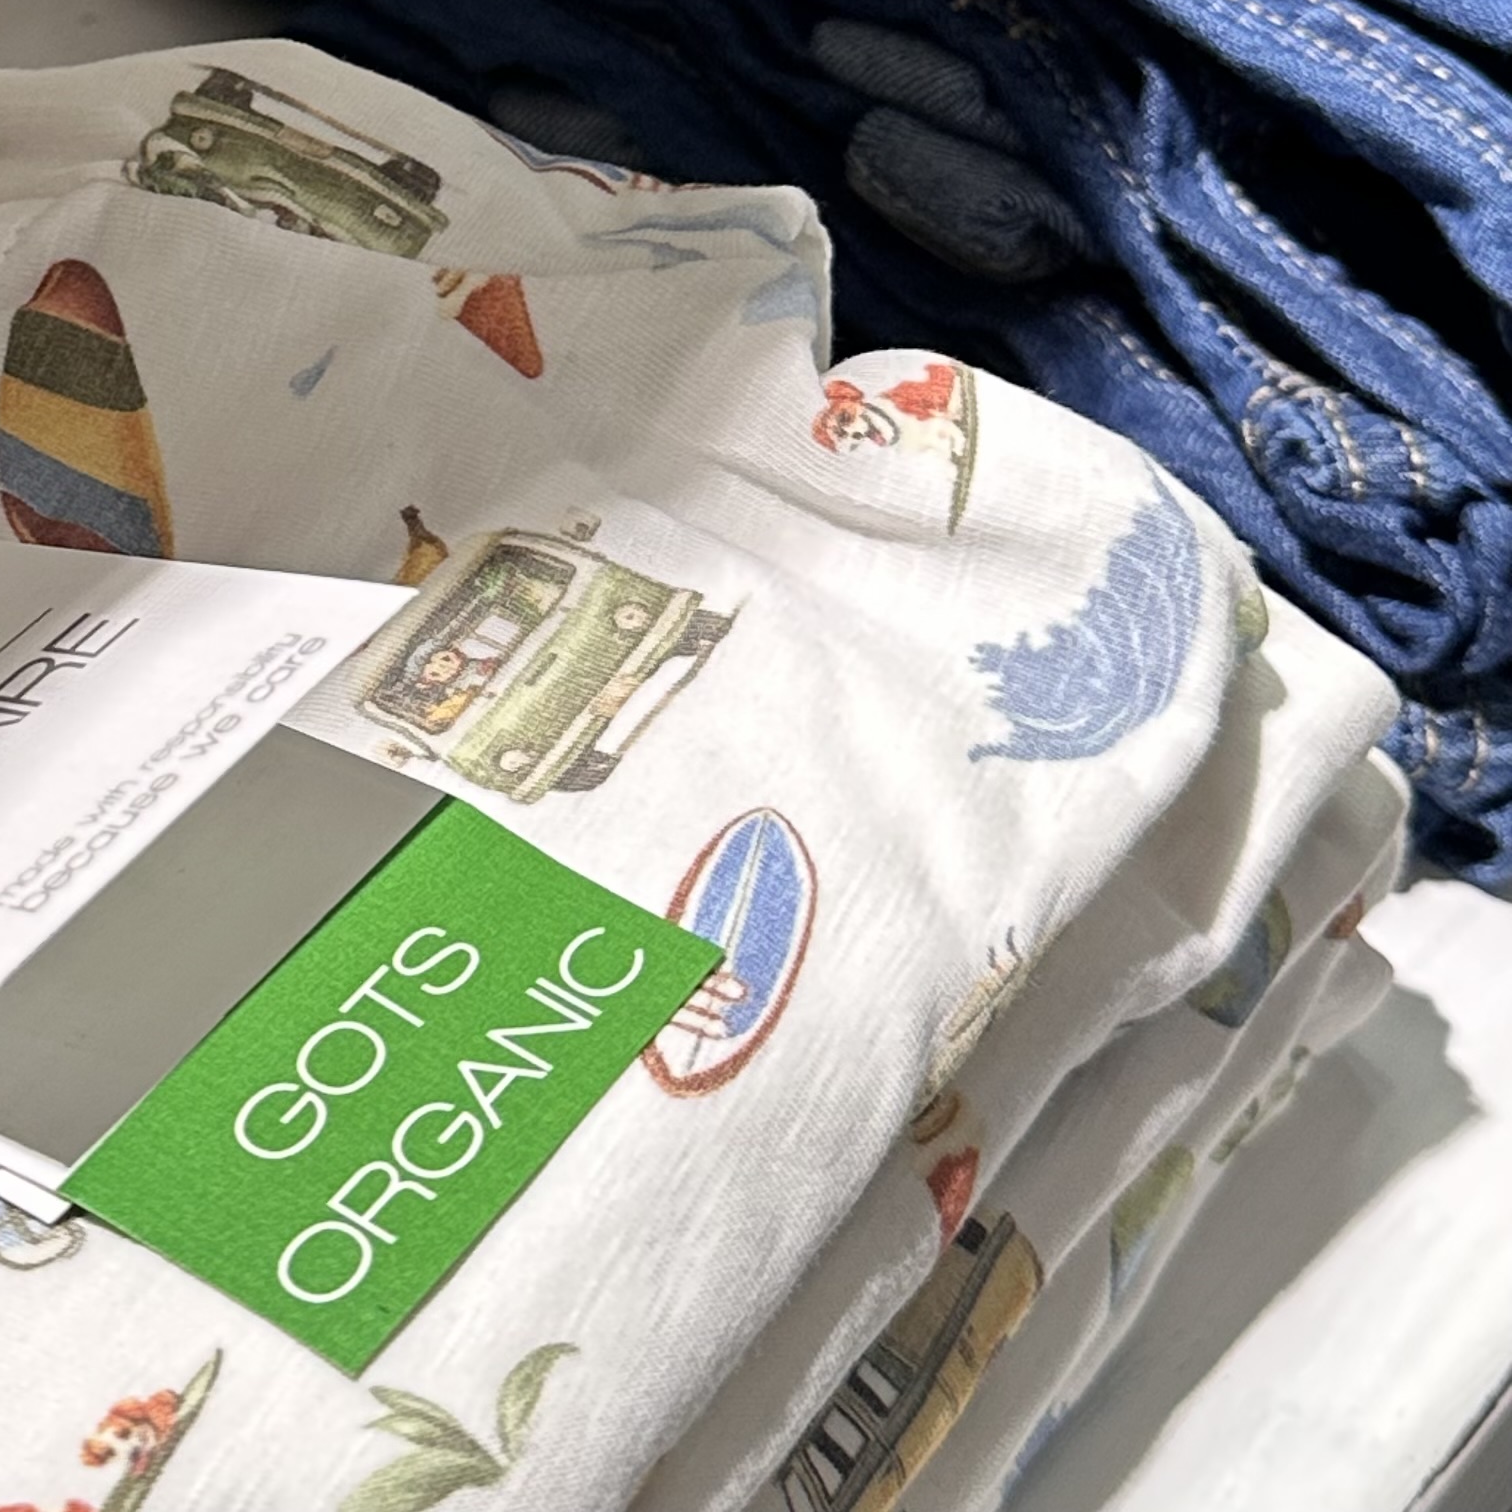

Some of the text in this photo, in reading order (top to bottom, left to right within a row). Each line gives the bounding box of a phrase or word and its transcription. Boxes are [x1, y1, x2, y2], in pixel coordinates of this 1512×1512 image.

[9, 635, 328, 913] because we care
[76, 779, 138, 827] with
[139, 632, 304, 772] responsibility
[233, 925, 481, 1160] GOTS
[276, 926, 646, 1305] ORGANIC
